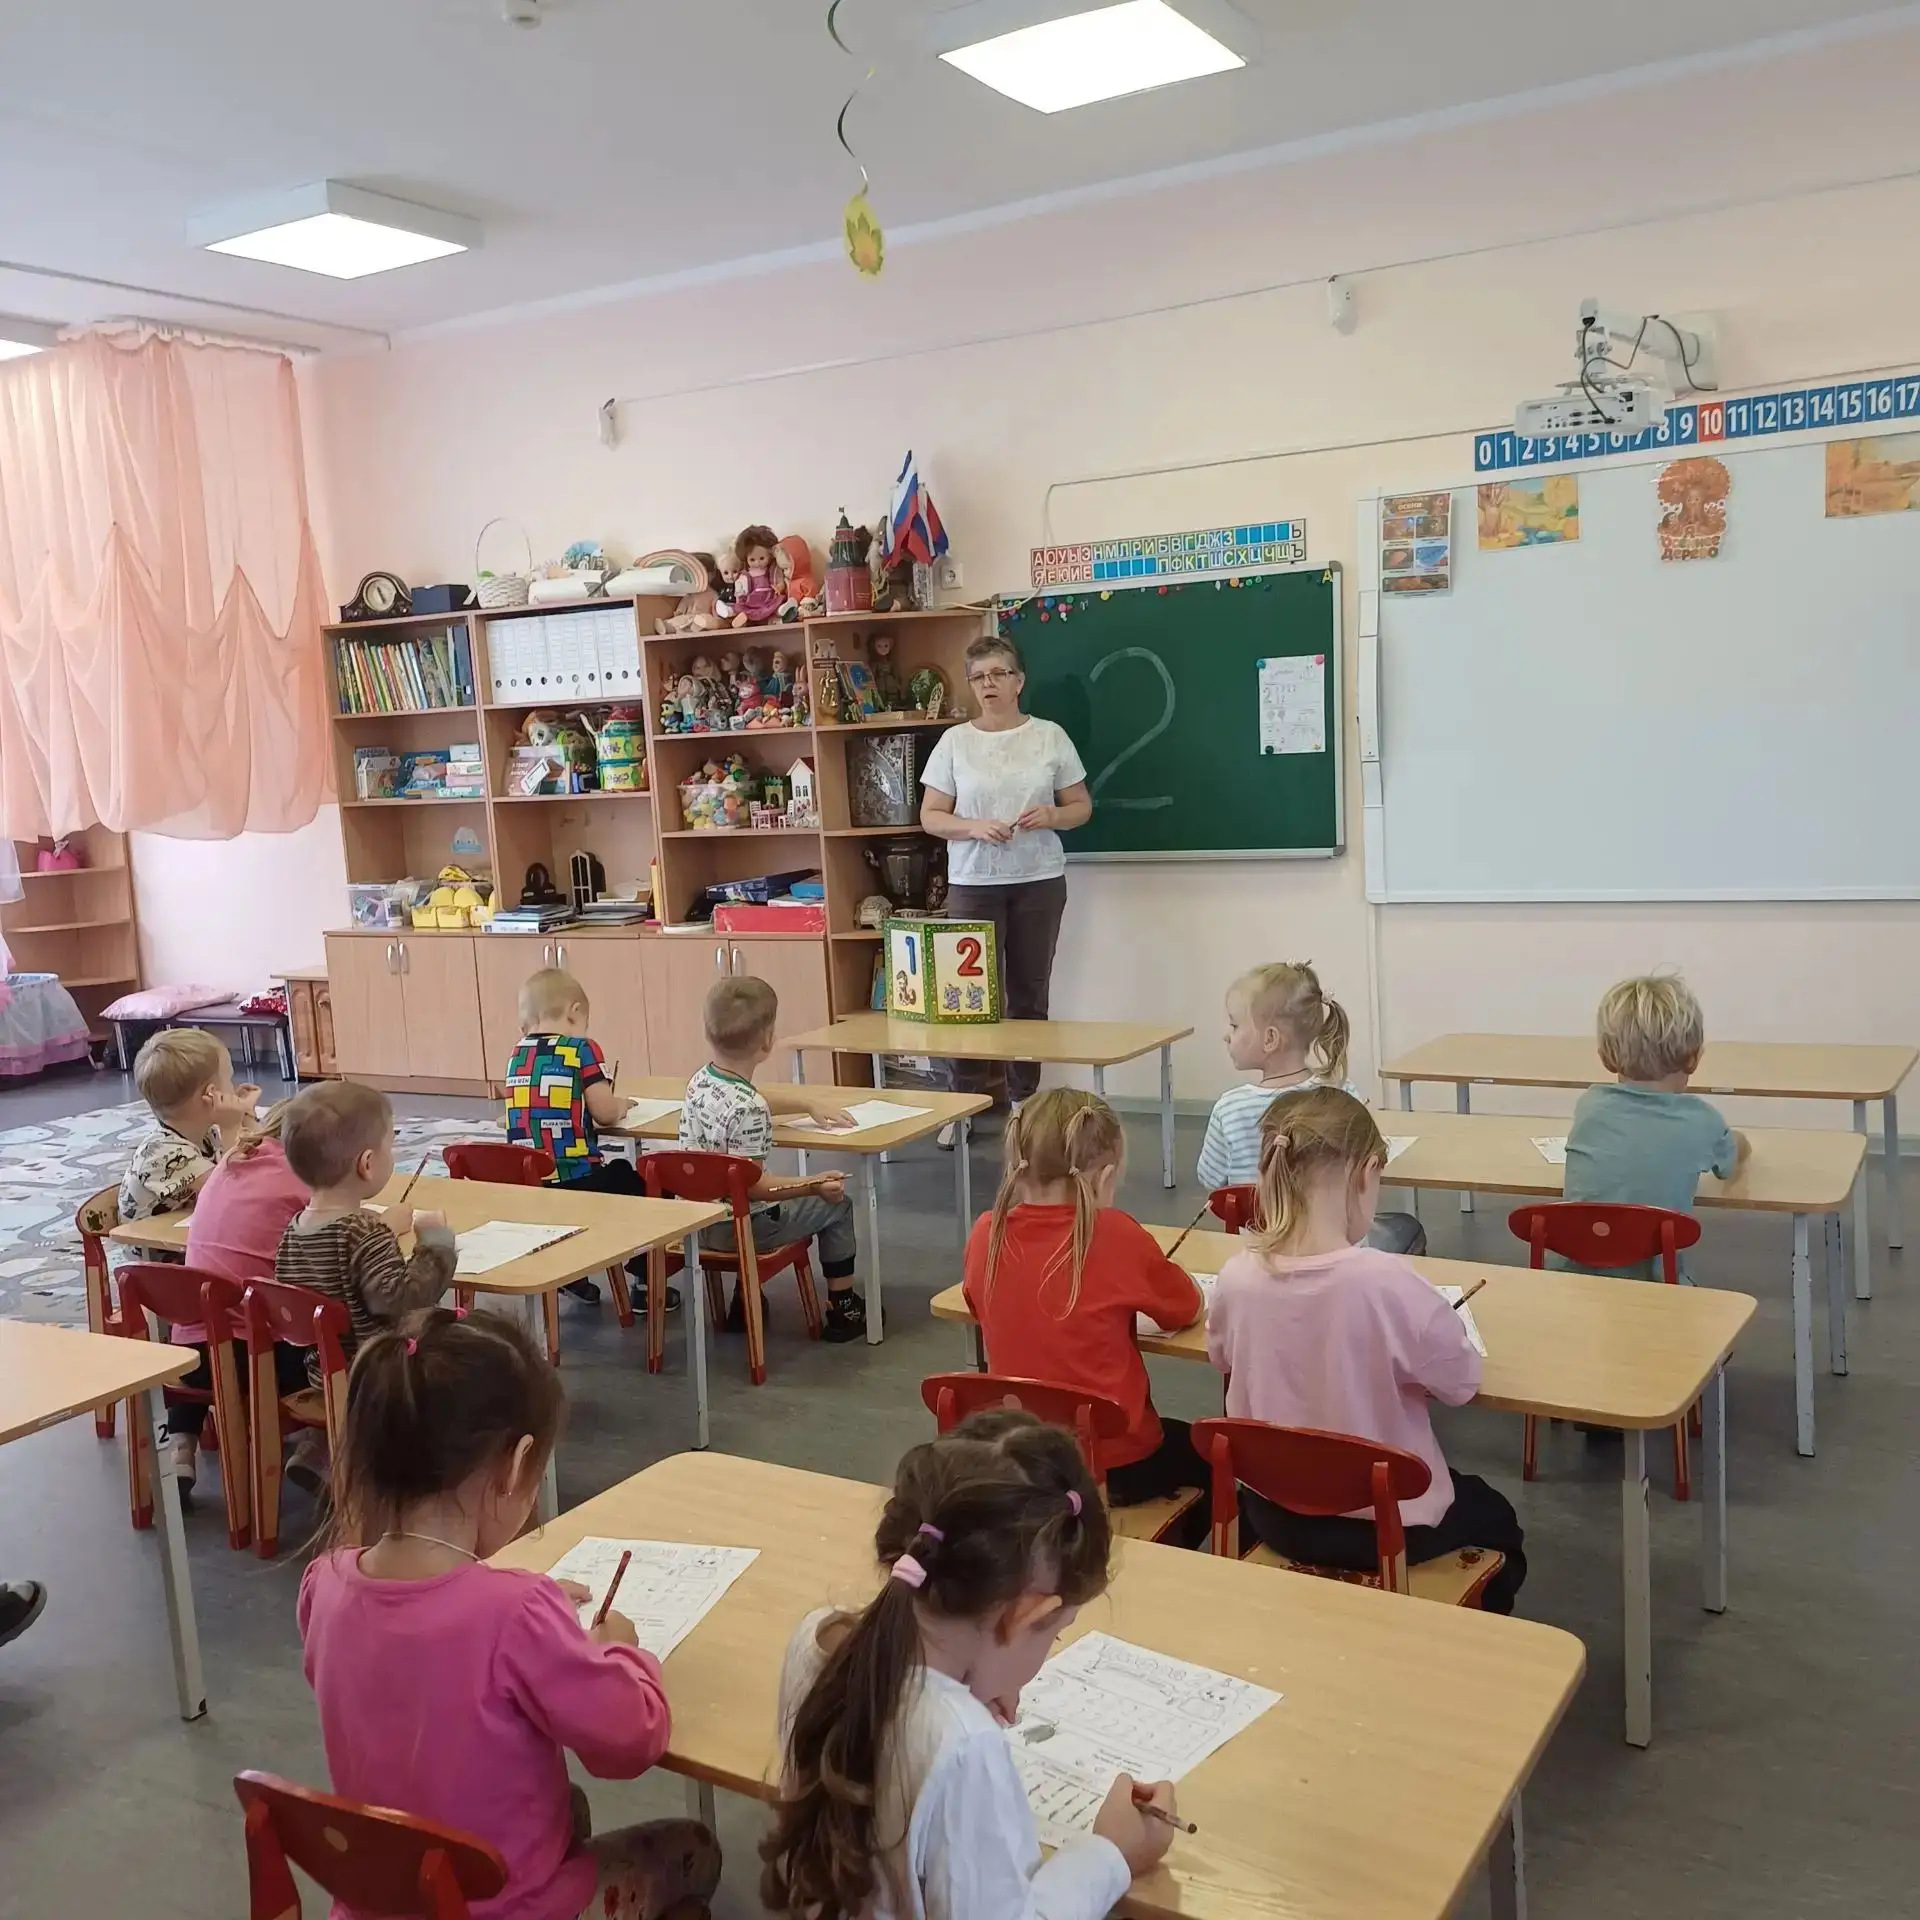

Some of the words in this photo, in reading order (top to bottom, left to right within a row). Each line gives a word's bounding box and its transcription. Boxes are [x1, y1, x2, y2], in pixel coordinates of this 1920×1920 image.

[1479, 440, 1491, 465] 0
[1501, 437, 1510, 462] 1
[1522, 437, 1534, 460] 2
[1544, 436, 1555, 457] 3
[1565, 433, 1579, 453] 4
[1657, 416, 1670, 441] 8
[1680, 412, 1694, 439] 9
[1701, 408, 1723, 436] 10
[1727, 404, 1748, 433] 11
[1754, 401, 1777, 429] 12
[1782, 397, 1805, 426] 13
[1810, 393, 1834, 422] 14
[1838, 390, 1862, 419] 15
[1866, 386, 1892, 416] 16
[1896, 382, 1920, 411] 17
[1089, 646, 1176, 809] 2
[905, 936, 916, 975] 1
[956, 937, 983, 976] 2
[158, 1423, 170, 1444] 2
